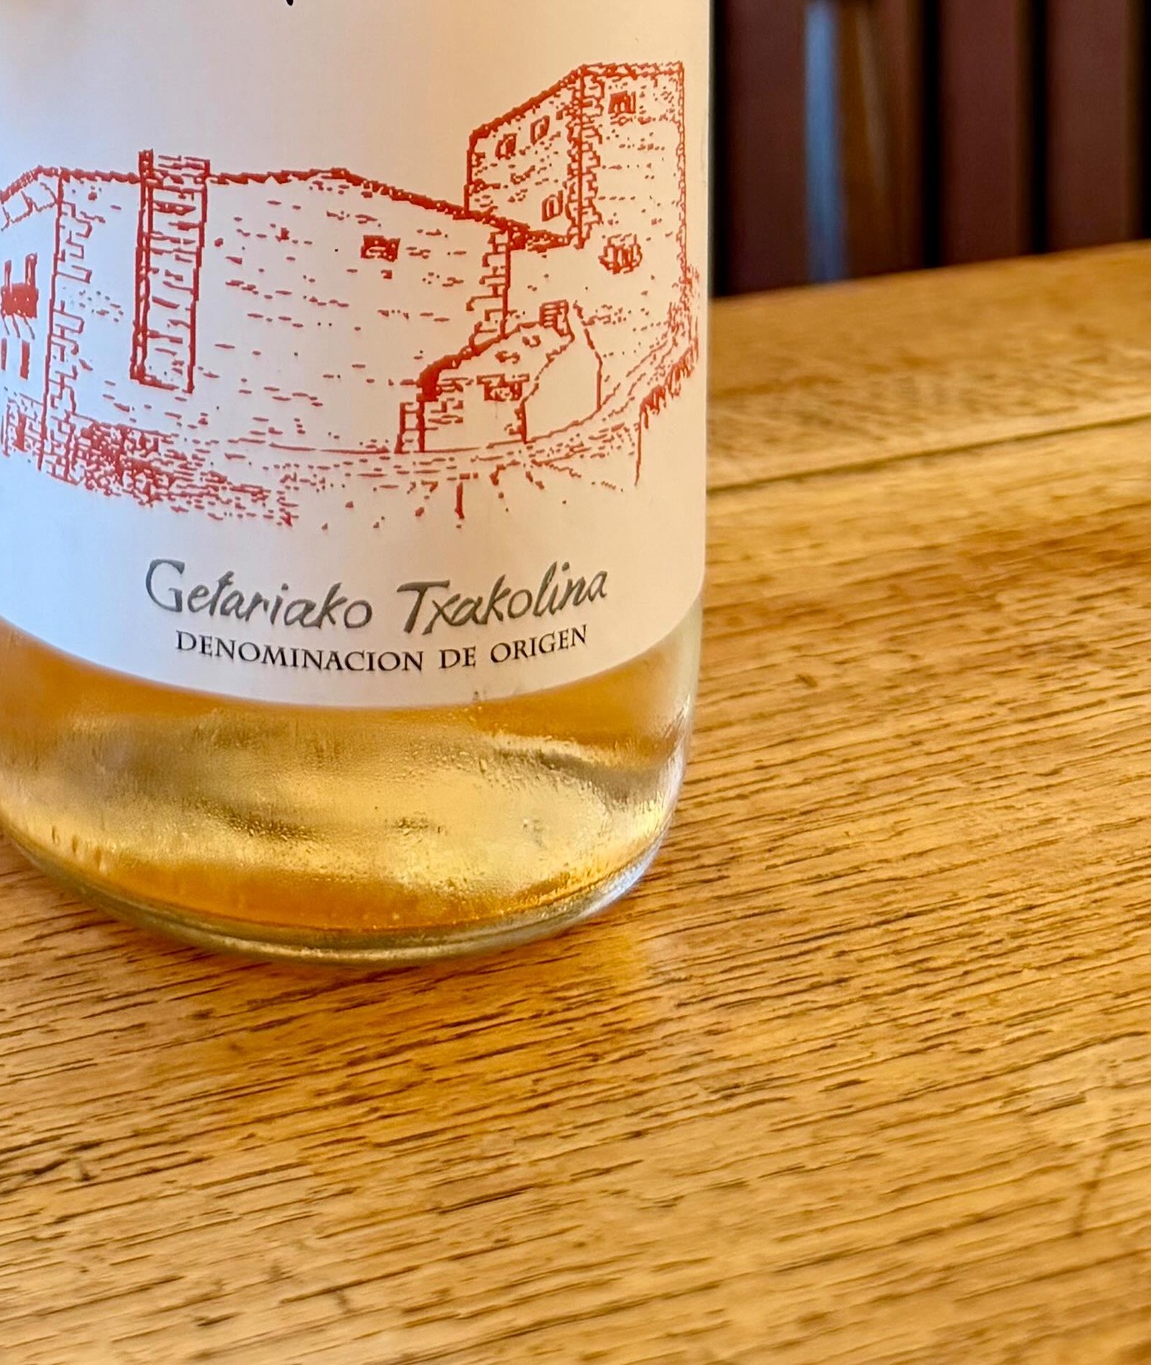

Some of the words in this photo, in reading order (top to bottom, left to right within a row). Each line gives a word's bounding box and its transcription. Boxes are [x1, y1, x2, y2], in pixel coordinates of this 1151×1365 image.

[145, 558, 373, 630] Getariako
[396, 561, 609, 636] Txakolina
[175, 630, 424, 672] DENOMINACION
[438, 645, 477, 670] DE
[490, 624, 588, 664] ORIGEN
